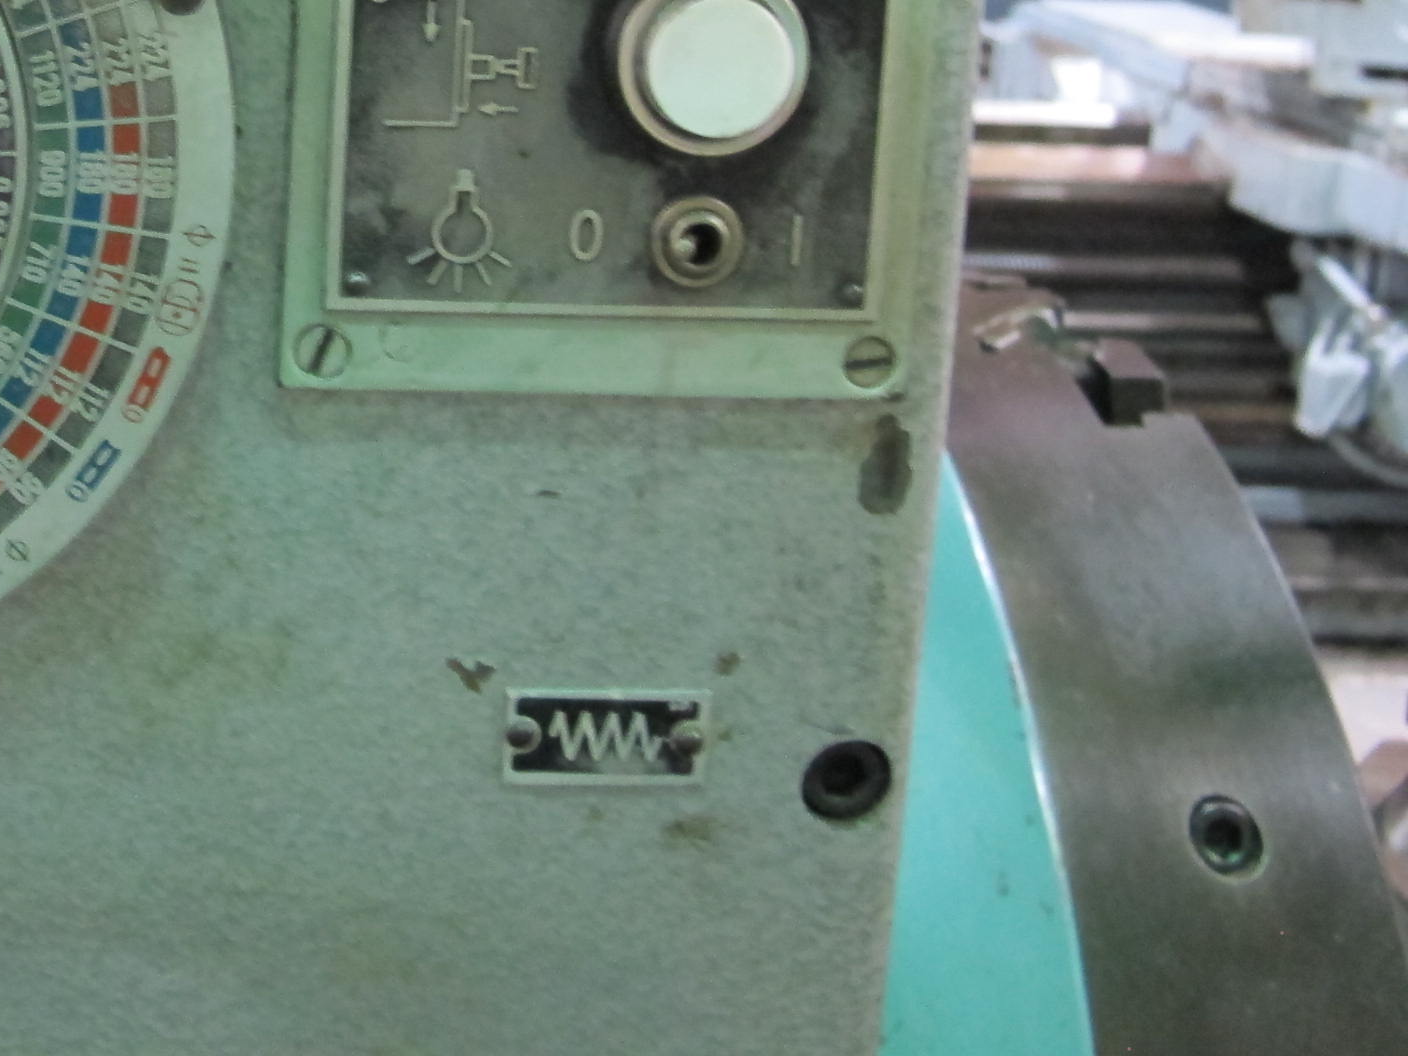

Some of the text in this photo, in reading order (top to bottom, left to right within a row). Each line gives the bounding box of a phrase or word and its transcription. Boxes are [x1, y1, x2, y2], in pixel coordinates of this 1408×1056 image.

[28, 50, 62, 107] 1120
[62, 41, 95, 92] 224
[35, 149, 66, 198] 900
[19, 240, 55, 284] 710
[54, 252, 89, 296] 140
[14, 347, 49, 385] 112
[43, 364, 81, 404] 112
[72, 381, 110, 422] 112
